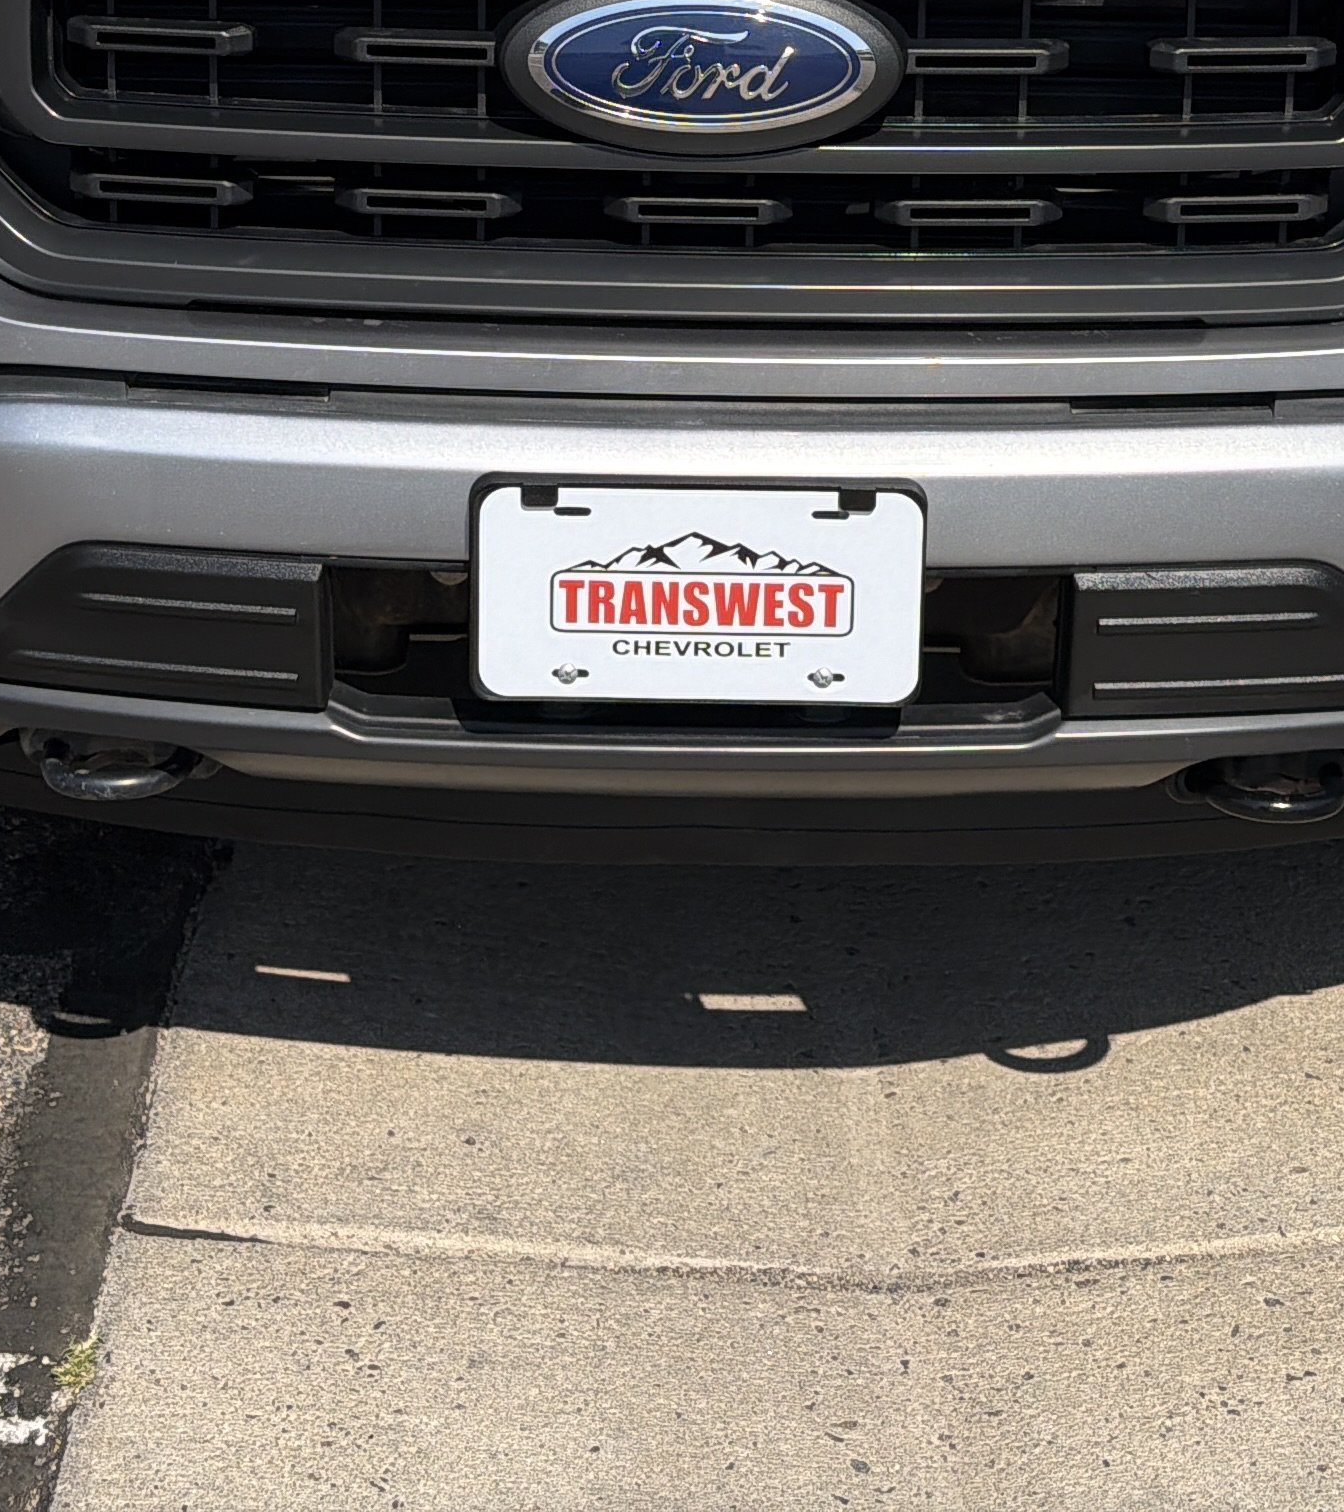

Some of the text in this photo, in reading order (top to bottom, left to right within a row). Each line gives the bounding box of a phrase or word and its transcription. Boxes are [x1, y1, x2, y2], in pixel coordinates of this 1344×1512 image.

[611, 25, 796, 101] Ford
[558, 579, 845, 629] TRANSWEST
[611, 638, 792, 658] CHEVROLET
